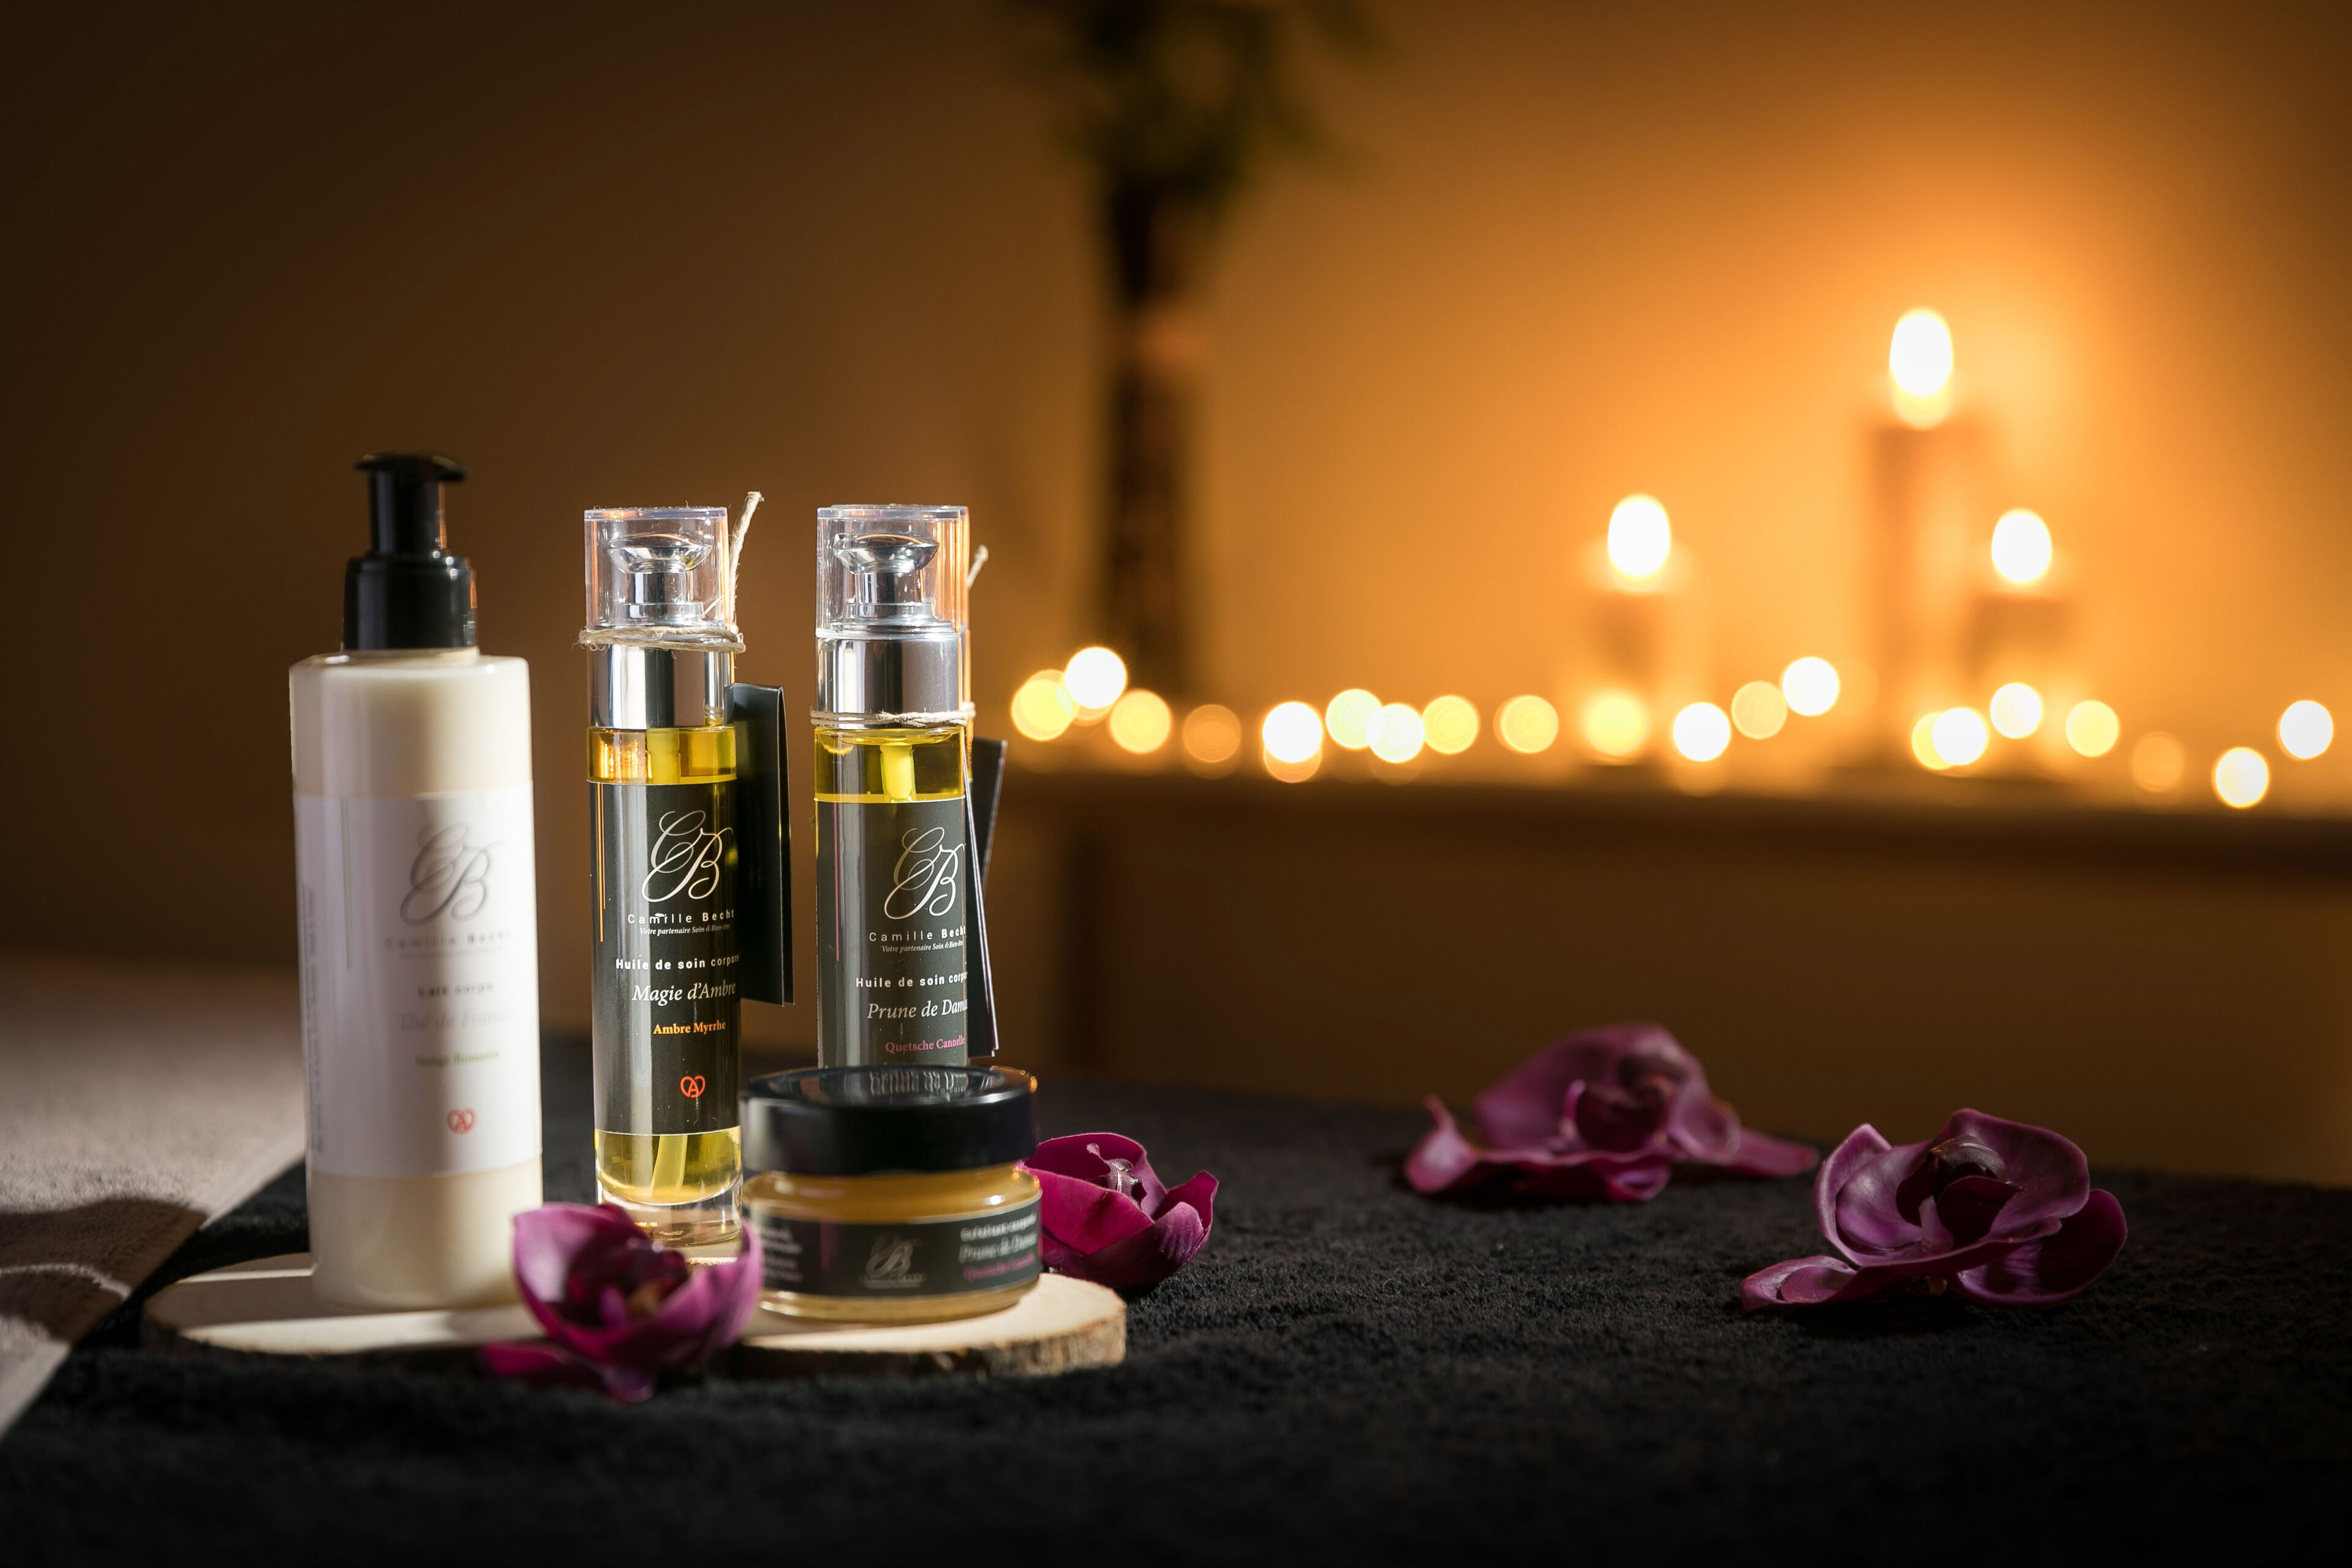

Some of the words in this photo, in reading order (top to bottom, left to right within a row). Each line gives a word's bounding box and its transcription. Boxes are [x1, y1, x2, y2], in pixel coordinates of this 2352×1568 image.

[627, 913, 692, 925] Camille
[702, 909, 734, 922] Becht
[639, 927, 657, 935] Votre
[657, 927, 691, 937] partenaire
[869, 931, 933, 942] Camille
[900, 944, 932, 954] partenaire
[932, 942, 944, 951] Soin
[616, 958, 649, 970] Huile
[655, 959, 672, 970] de
[677, 957, 706, 969] soin
[856, 977, 891, 987] Huile
[898, 976, 913, 987] de
[919, 974, 945, 987] soin
[631, 985, 683, 1006] Magie
[867, 1003, 917, 1019] Prune
[921, 1000, 938, 1018] de
[652, 1023, 691, 1035] Ambre
[693, 1019, 726, 1035] Myrrhe
[885, 1039, 934, 1054] Quetsche
[936, 1035, 965, 1050] Cannelle
